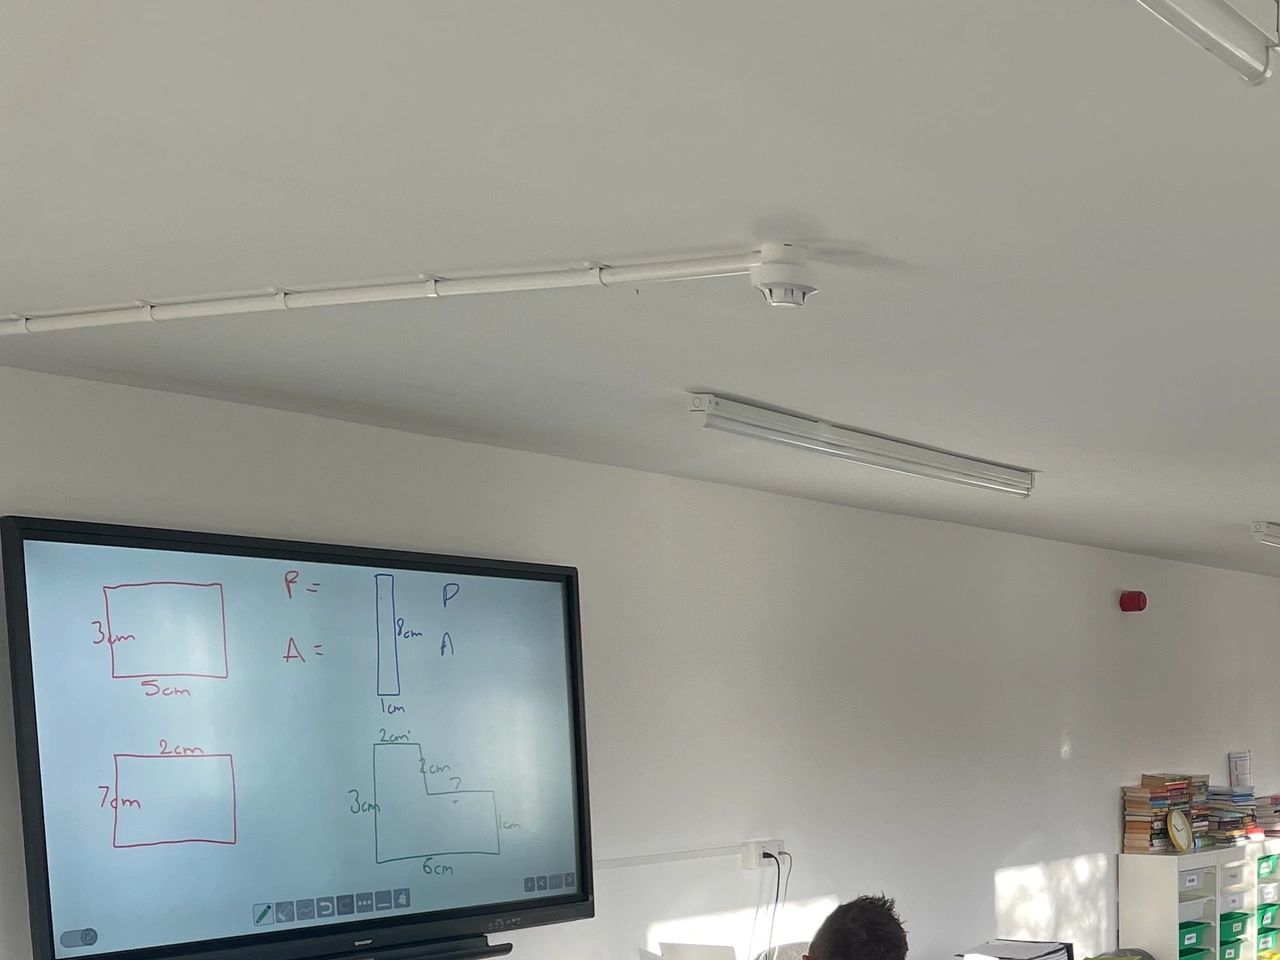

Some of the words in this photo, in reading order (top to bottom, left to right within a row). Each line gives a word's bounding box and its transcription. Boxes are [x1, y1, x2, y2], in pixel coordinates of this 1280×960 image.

[442, 582, 460, 608] P
[91, 620, 136, 645] 3cm
[283, 637, 306, 663] A
[440, 632, 454, 656] A
[141, 679, 191, 697] 5cm
[380, 698, 406, 715] 1cm
[379, 728, 410, 743] 2cm
[159, 739, 204, 755] 2cm
[418, 757, 451, 775] 2cm
[98, 785, 142, 810] 7cm
[347, 789, 381, 814] 3cm
[422, 857, 454, 876] 6cm
